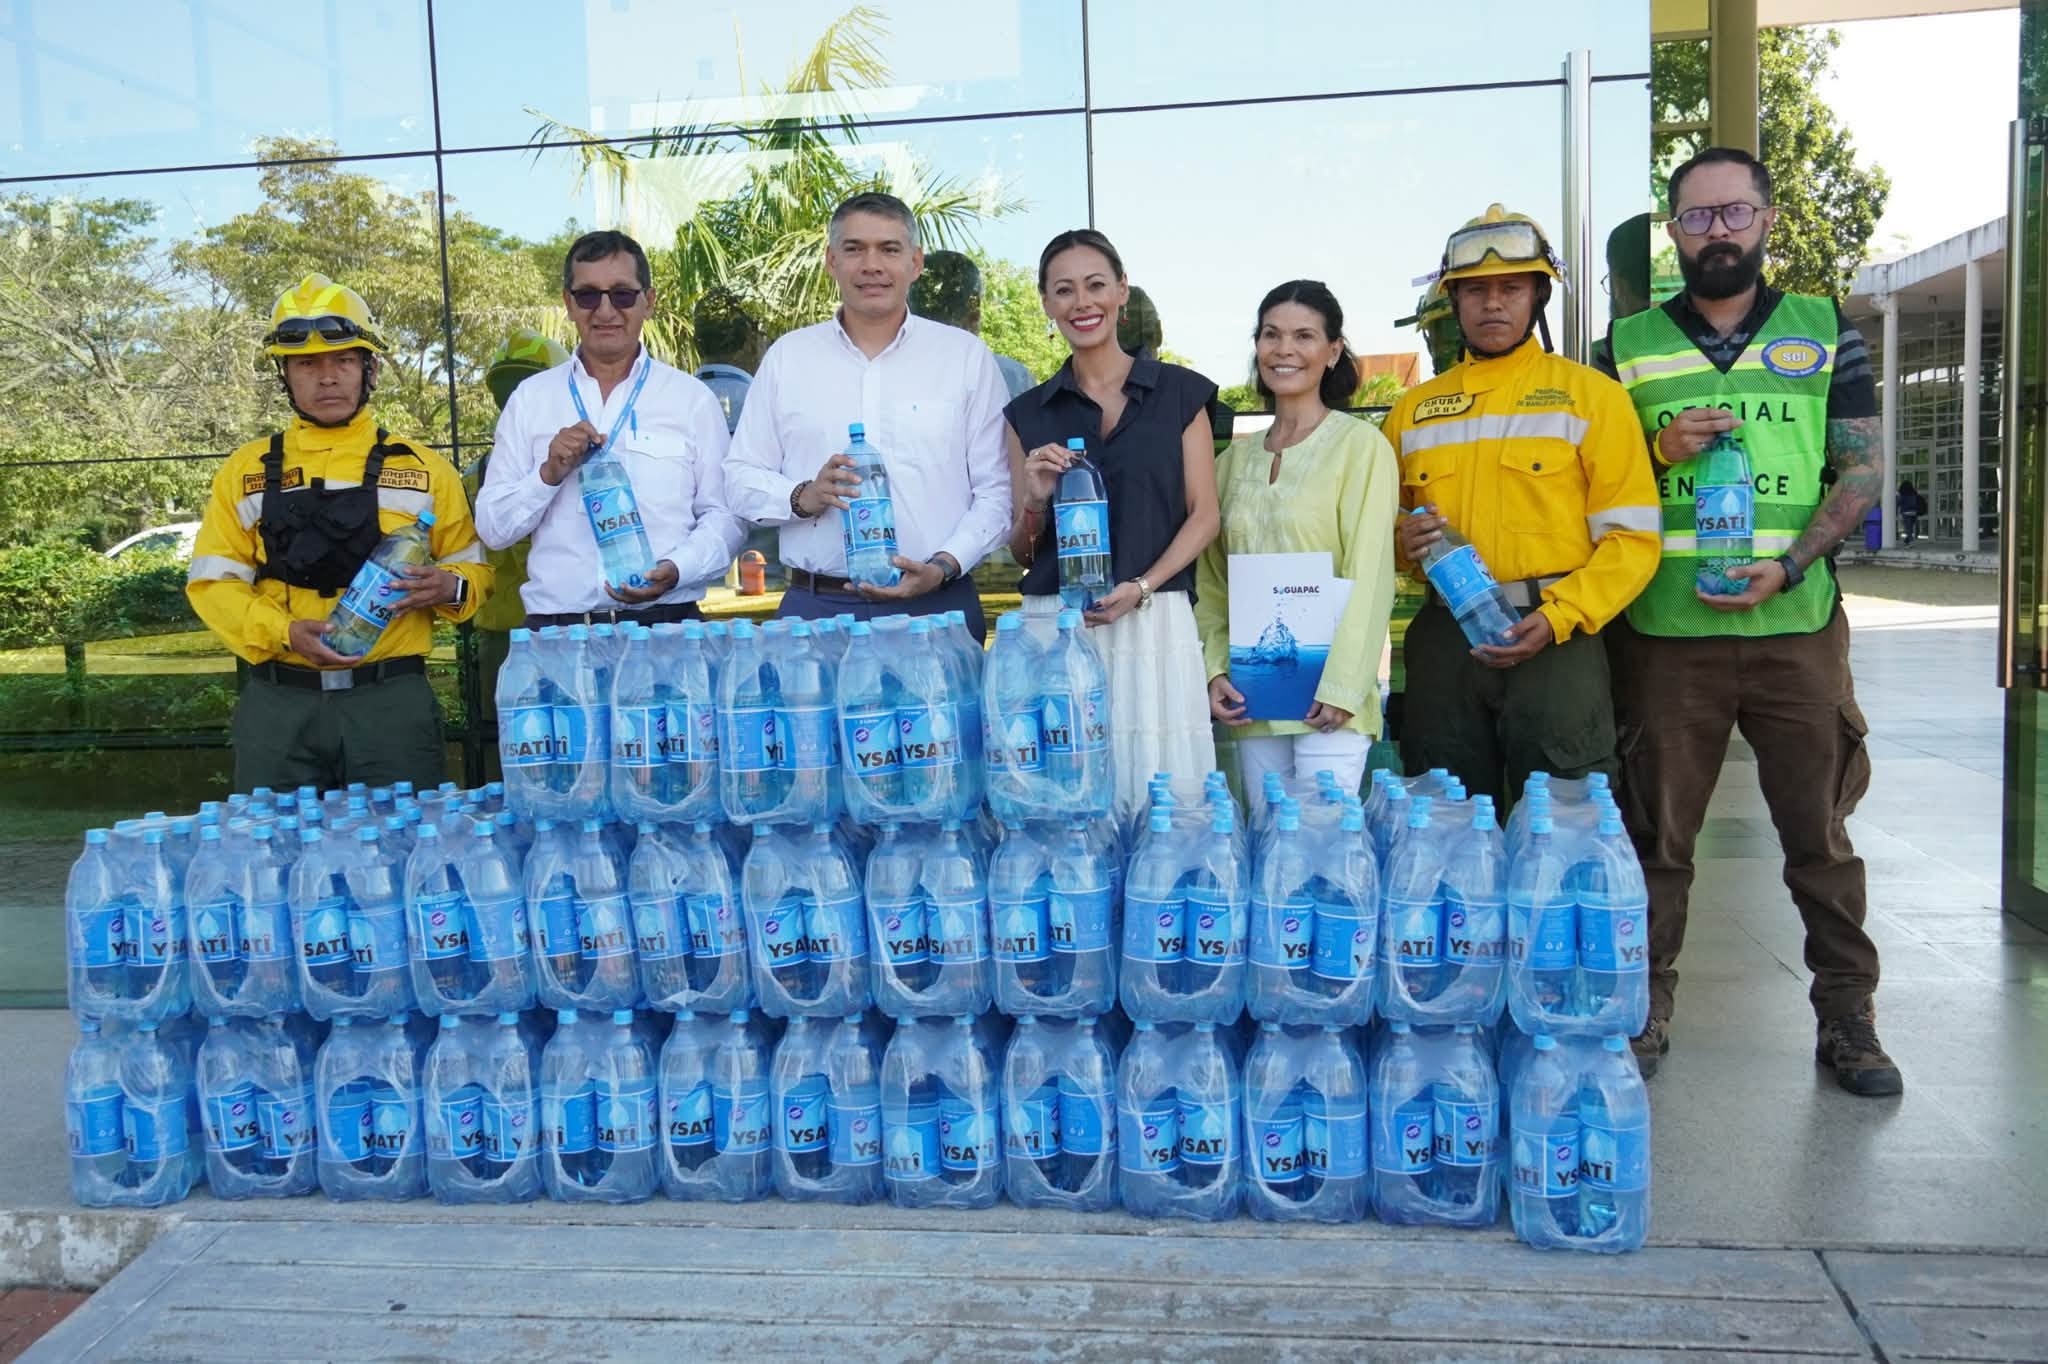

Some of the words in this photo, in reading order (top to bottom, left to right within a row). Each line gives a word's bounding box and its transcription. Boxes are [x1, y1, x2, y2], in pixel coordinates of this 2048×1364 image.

[1424, 397, 1462, 408] CHURA
[1660, 473, 1788, 498] ENCE
[304, 931, 348, 956] SATÎ
